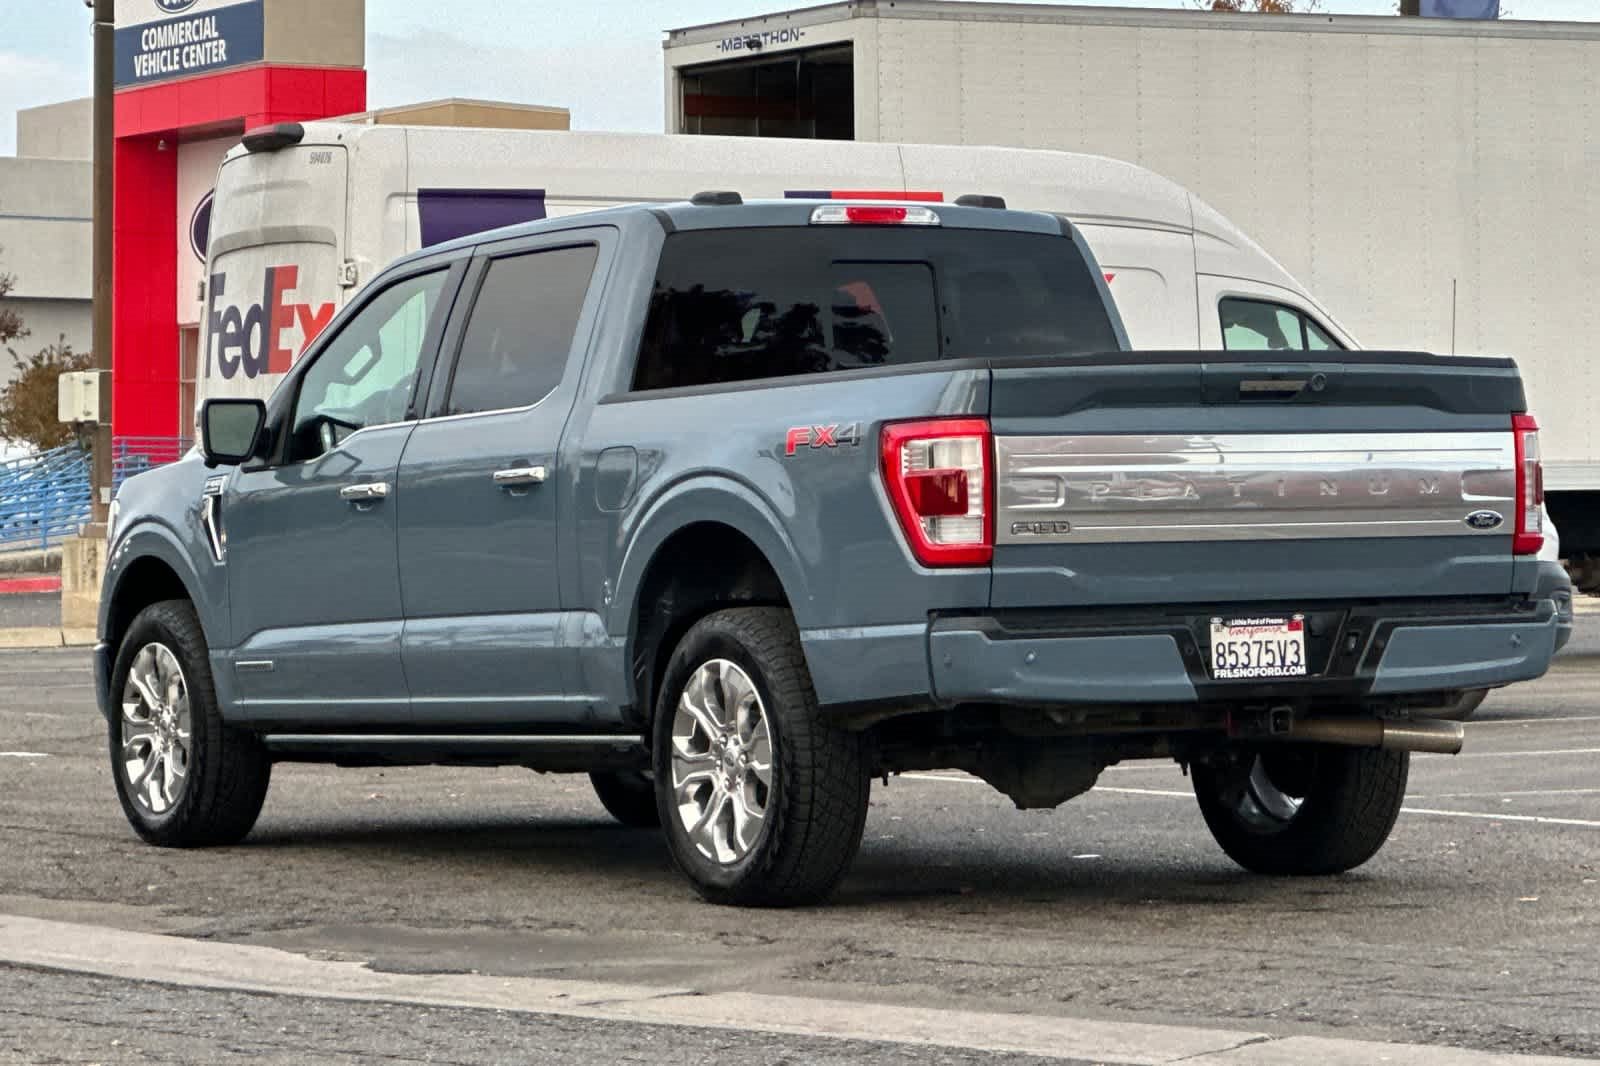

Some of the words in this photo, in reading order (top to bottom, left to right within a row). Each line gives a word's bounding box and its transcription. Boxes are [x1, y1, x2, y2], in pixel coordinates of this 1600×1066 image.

[141, 16, 219, 51] COMMERCIAL
[133, 47, 180, 77] VEHICLE
[182, 39, 227, 69] CENTER
[205, 265, 335, 379] FedEx
[785, 423, 860, 457] FX4
[1089, 478, 1440, 501] PLATINUM
[1011, 520, 1071, 535] F-150
[1216, 640, 1300, 668] 85375V3
[1214, 665, 1307, 679] FRESNOFORD.COM
